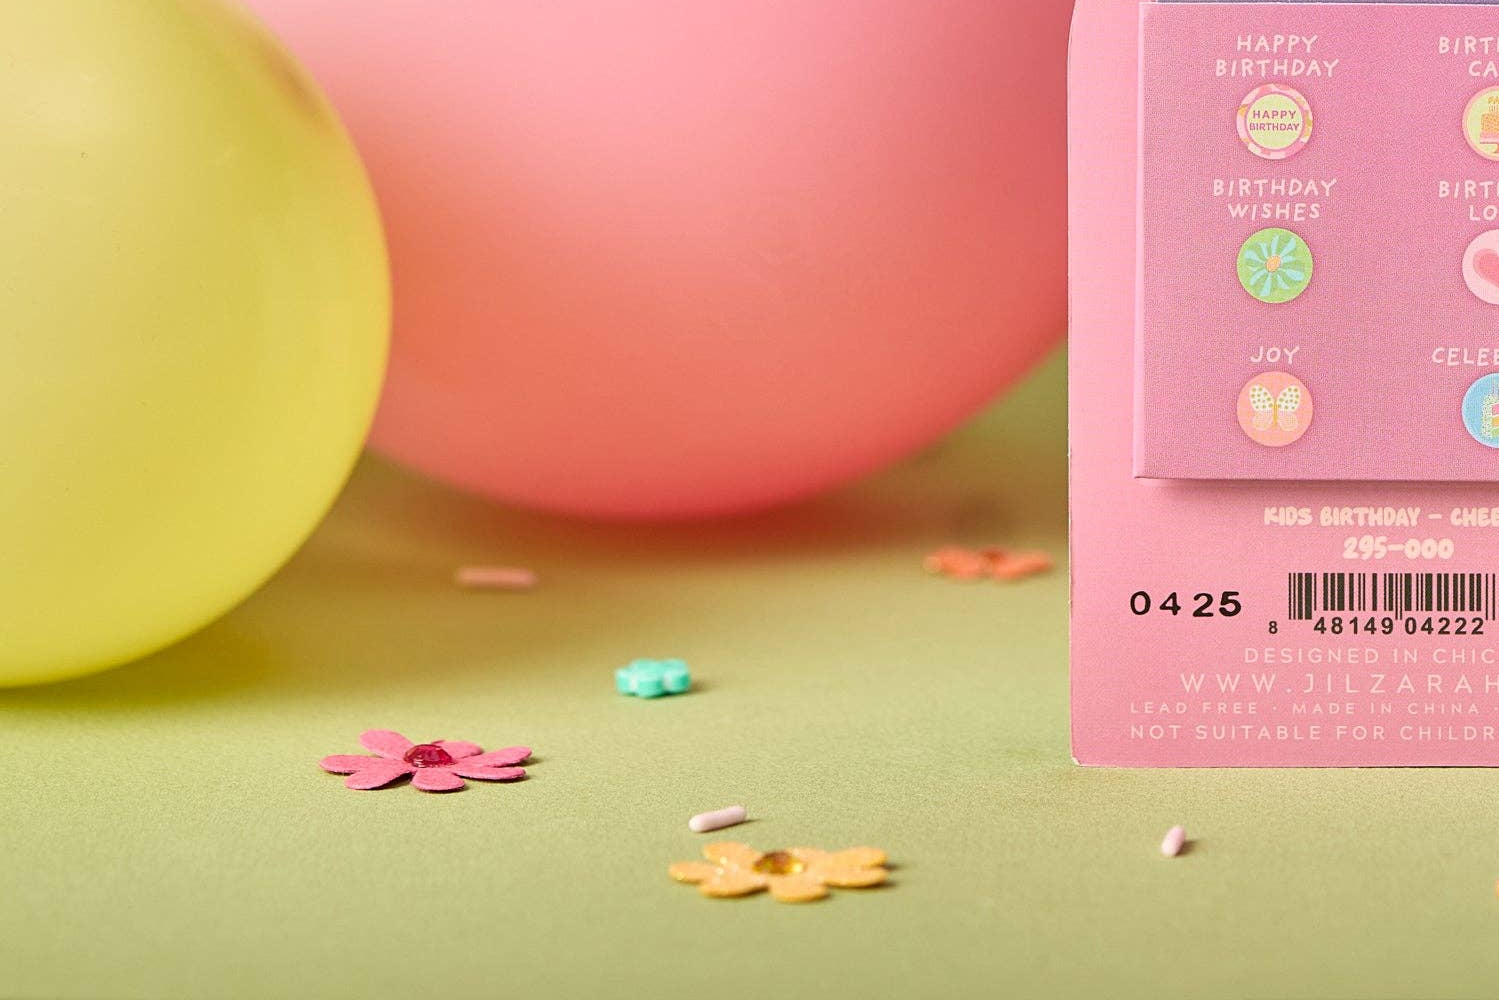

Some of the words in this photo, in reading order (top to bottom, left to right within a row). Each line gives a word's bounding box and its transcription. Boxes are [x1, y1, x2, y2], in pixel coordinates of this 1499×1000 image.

[1236, 35, 1318, 52] HAPPY
[1215, 58, 1339, 78] BIRTHDAY
[1253, 110, 1296, 120] HAPPY
[1249, 122, 1300, 132] BIRTHDAY
[1213, 178, 1337, 197] BIRTHDAY
[1228, 203, 1321, 221] WISHES
[1250, 346, 1300, 364] JOY
[1264, 507, 1314, 526] KIDS
[1320, 507, 1420, 527] BIRTHDAY
[1343, 538, 1454, 559] 295-000
[1268, 622, 1278, 635] 8
[1314, 617, 1394, 635] 48149
[1404, 617, 1484, 635] 04222
[1245, 649, 1380, 664] DESIGNED
[1394, 649, 1418, 664] IN
[1131, 702, 1188, 714] LEAD
[1202, 702, 1259, 715] FREE
[1293, 703, 1354, 715] MADE
[1366, 703, 1393, 715] IN
[1407, 703, 1481, 715] CHINA
[1131, 724, 1181, 740] NOT
[1196, 724, 1321, 740] SUITABLE
[1336, 725, 1385, 740] FOR
